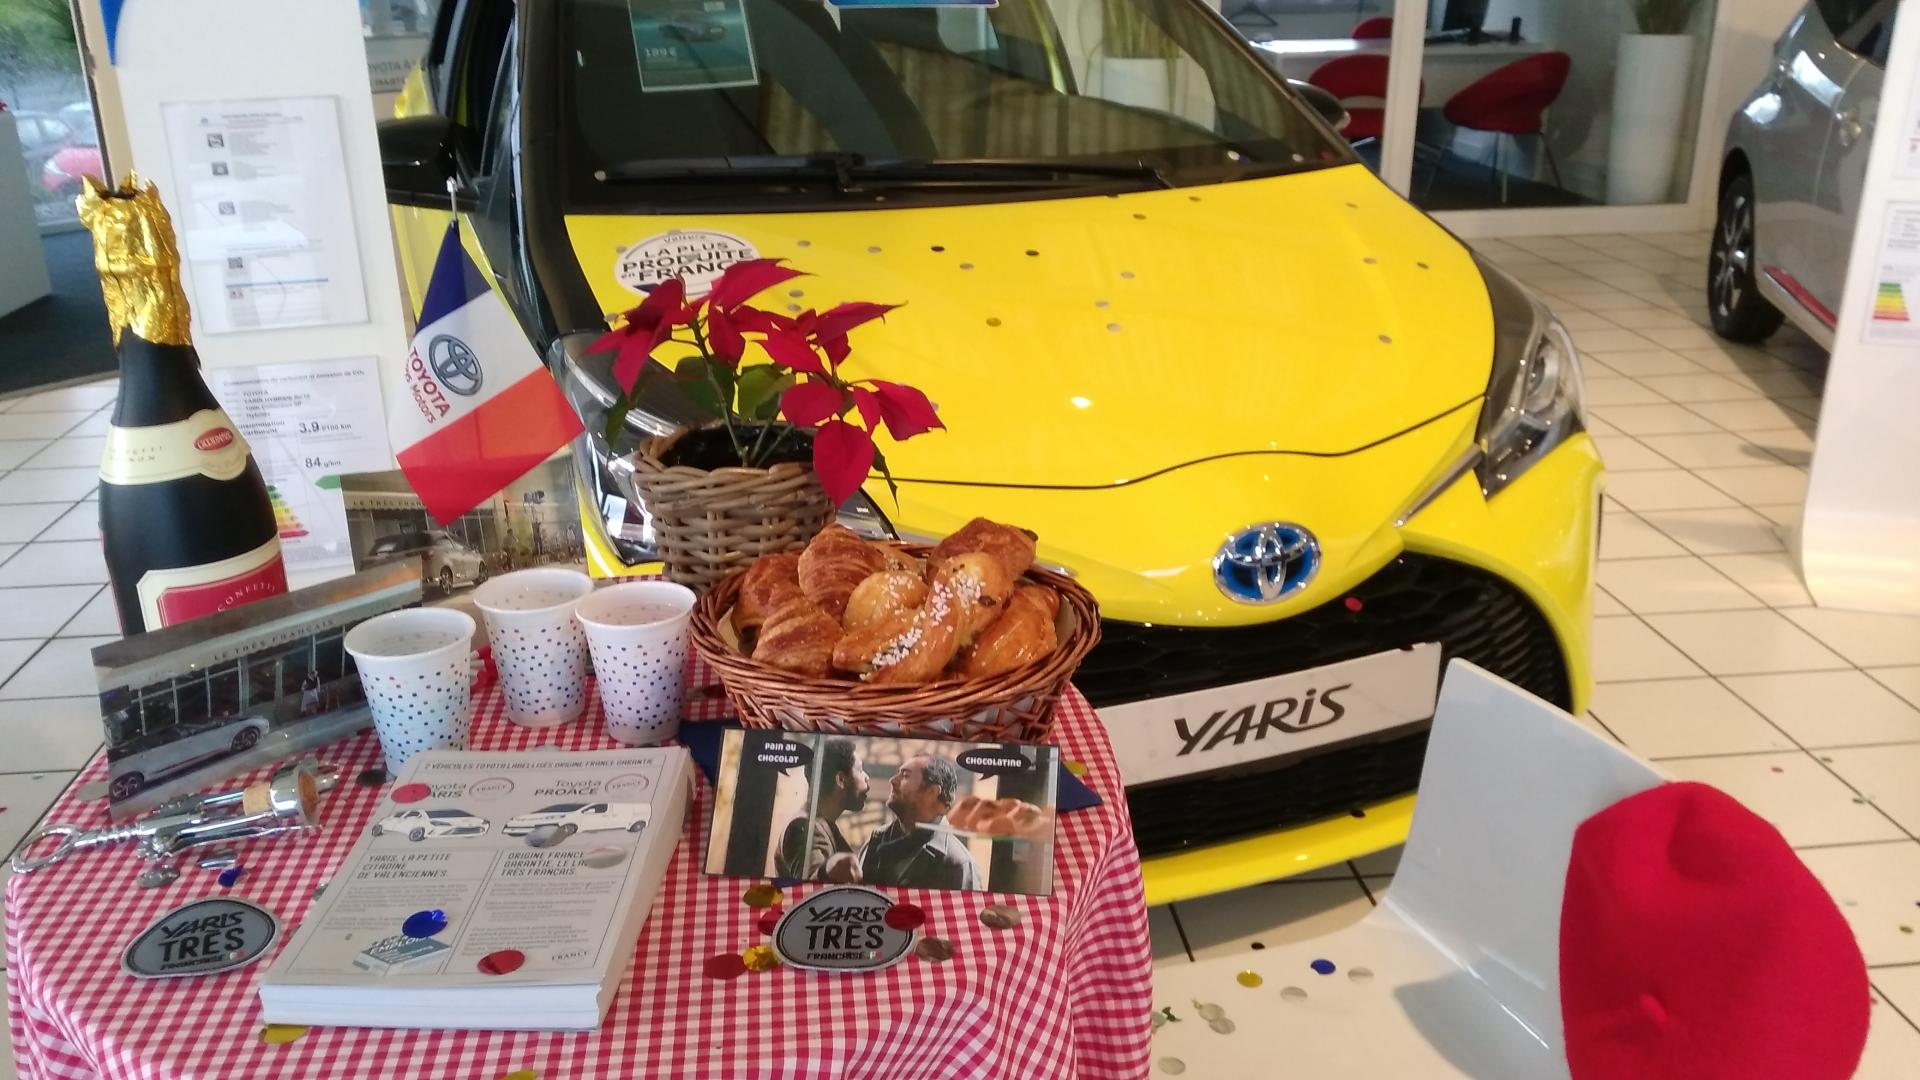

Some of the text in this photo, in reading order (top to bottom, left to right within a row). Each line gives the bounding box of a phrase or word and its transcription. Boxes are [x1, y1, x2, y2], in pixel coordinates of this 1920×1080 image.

[644, 242, 729, 258] LA PLUS
[622, 249, 754, 273] PRODUITE
[638, 260, 738, 282] FRANC
[409, 345, 451, 418] TOYOTA
[305, 457, 321, 469] 84
[217, 581, 275, 612] CONFETTI
[1174, 682, 1353, 757] YARIS
[764, 741, 797, 751] PAIN AU
[757, 753, 799, 764] CHOCOLAT
[965, 756, 1022, 768] CHOCOLATINE
[534, 788, 599, 796] PROACE
[555, 780, 602, 789] Toyota
[808, 906, 886, 922] YARIS
[161, 911, 245, 939] YARIS
[158, 927, 244, 963] TRÈS
[805, 920, 885, 951] TRÈS
